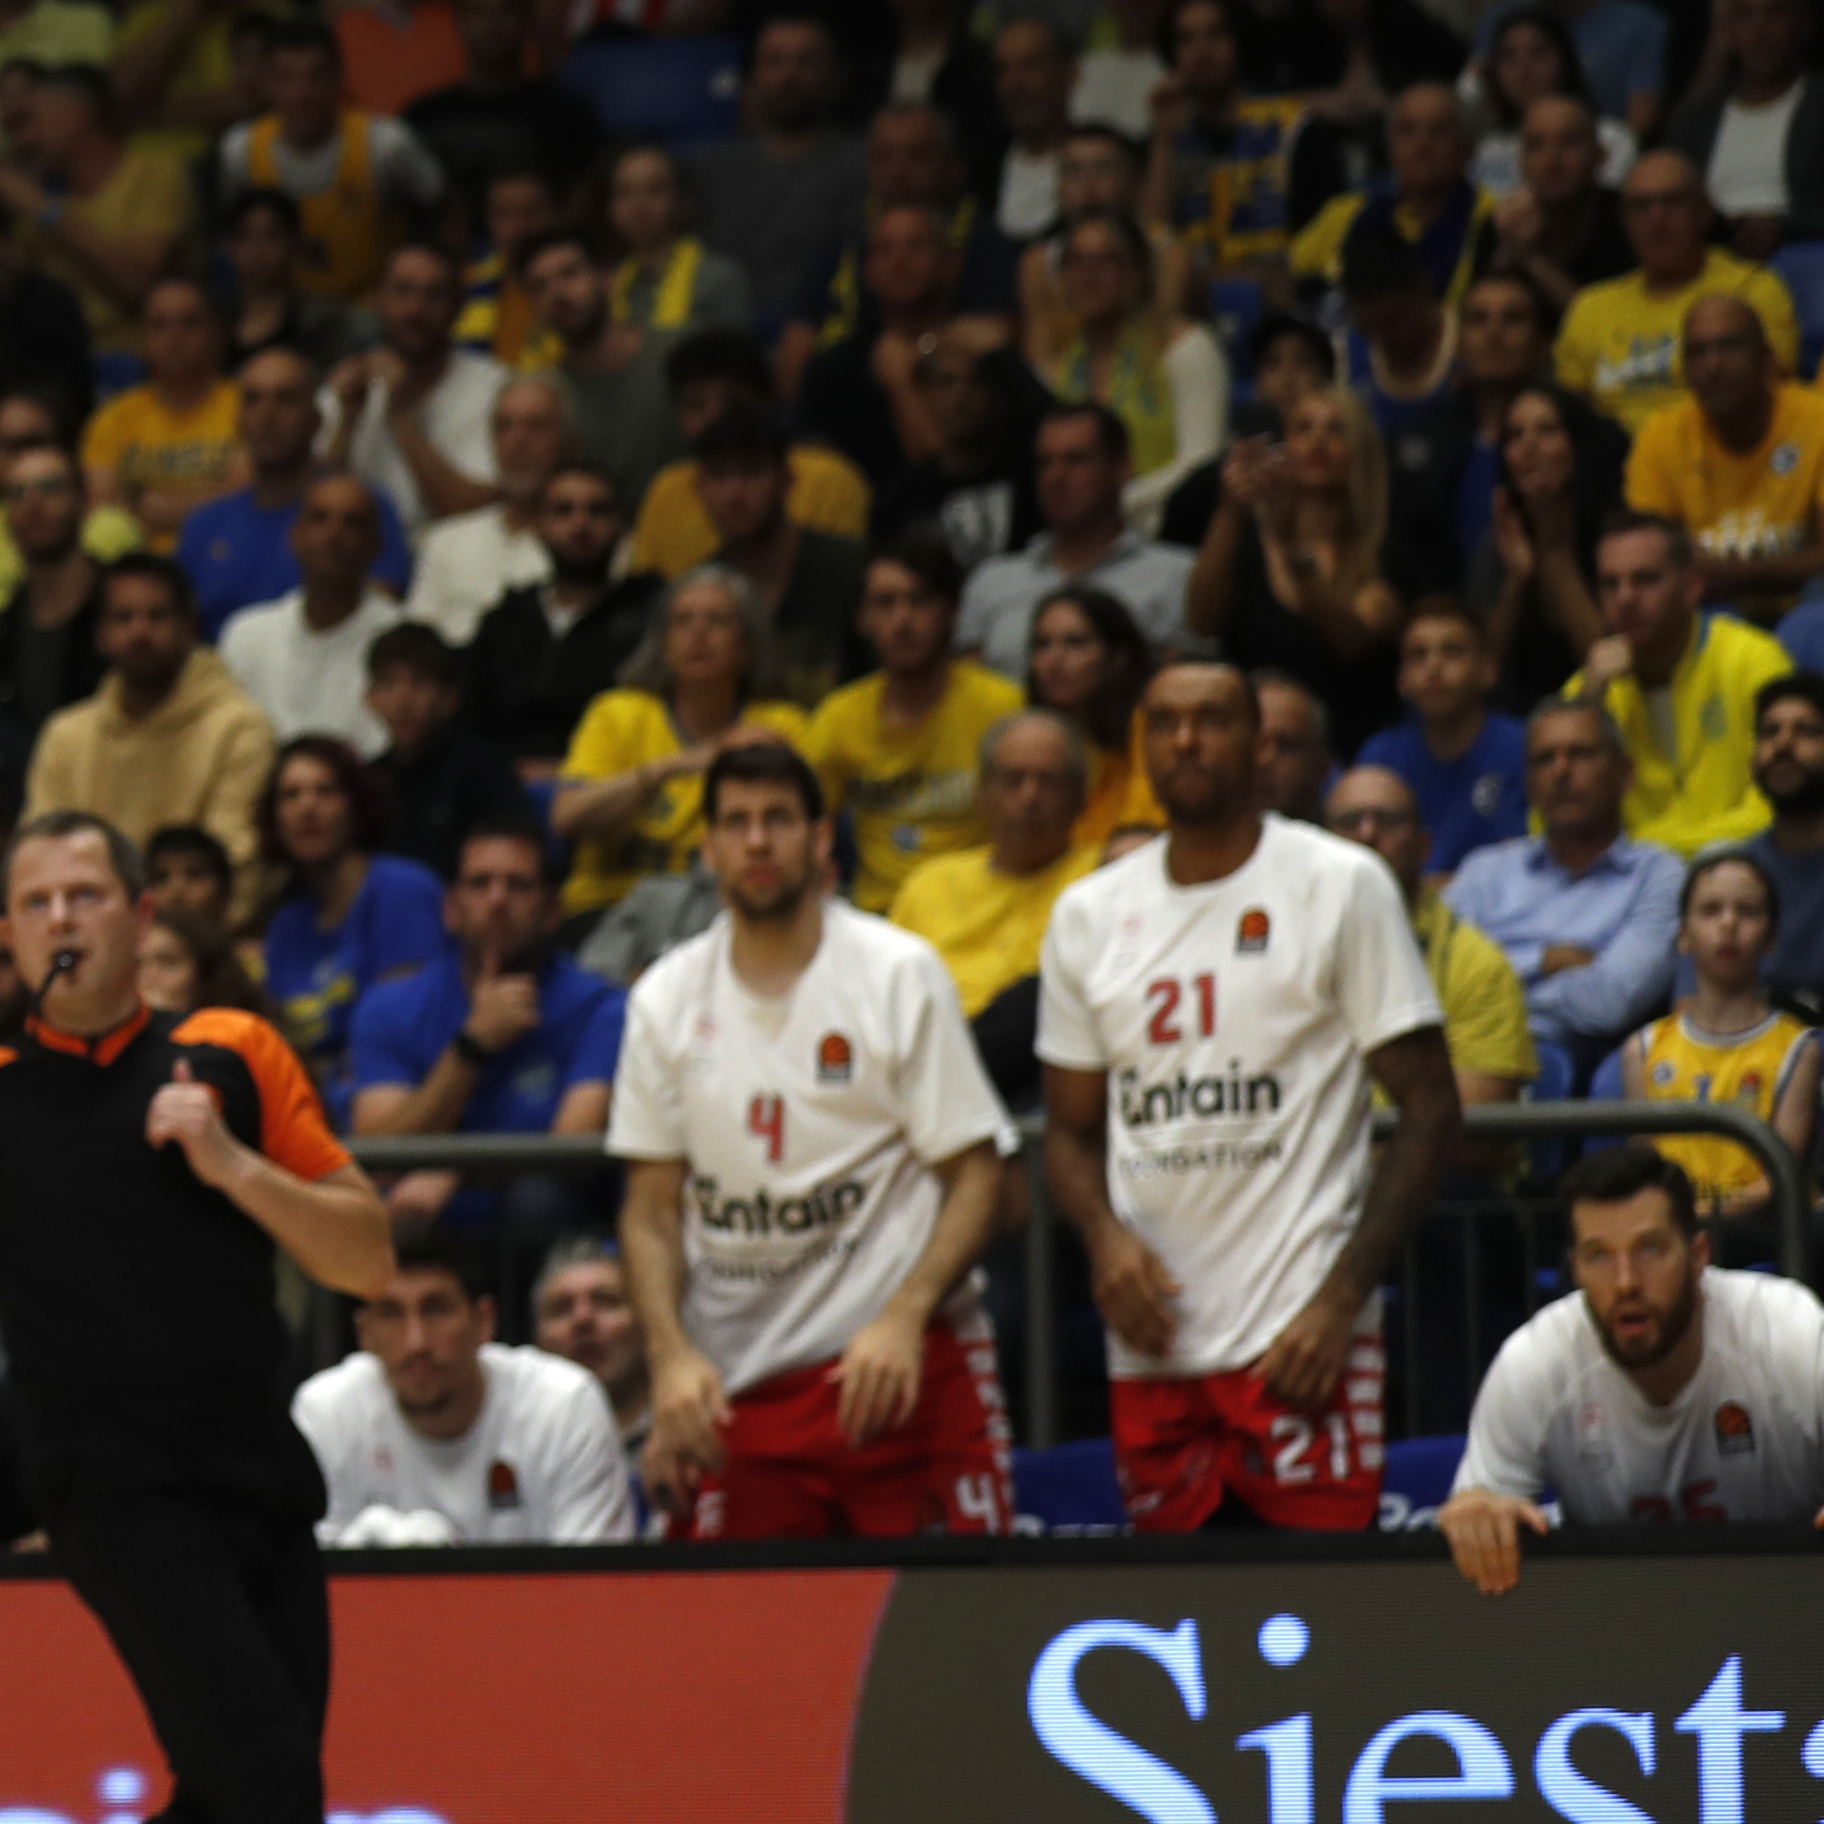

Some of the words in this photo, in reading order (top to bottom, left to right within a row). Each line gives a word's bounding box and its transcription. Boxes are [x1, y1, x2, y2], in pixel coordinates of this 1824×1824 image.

[1147, 970, 1216, 1047] 21
[748, 1092, 785, 1163] 4
[1270, 1410, 1350, 1486] 21
[1027, 1612, 1824, 1824] Siest
